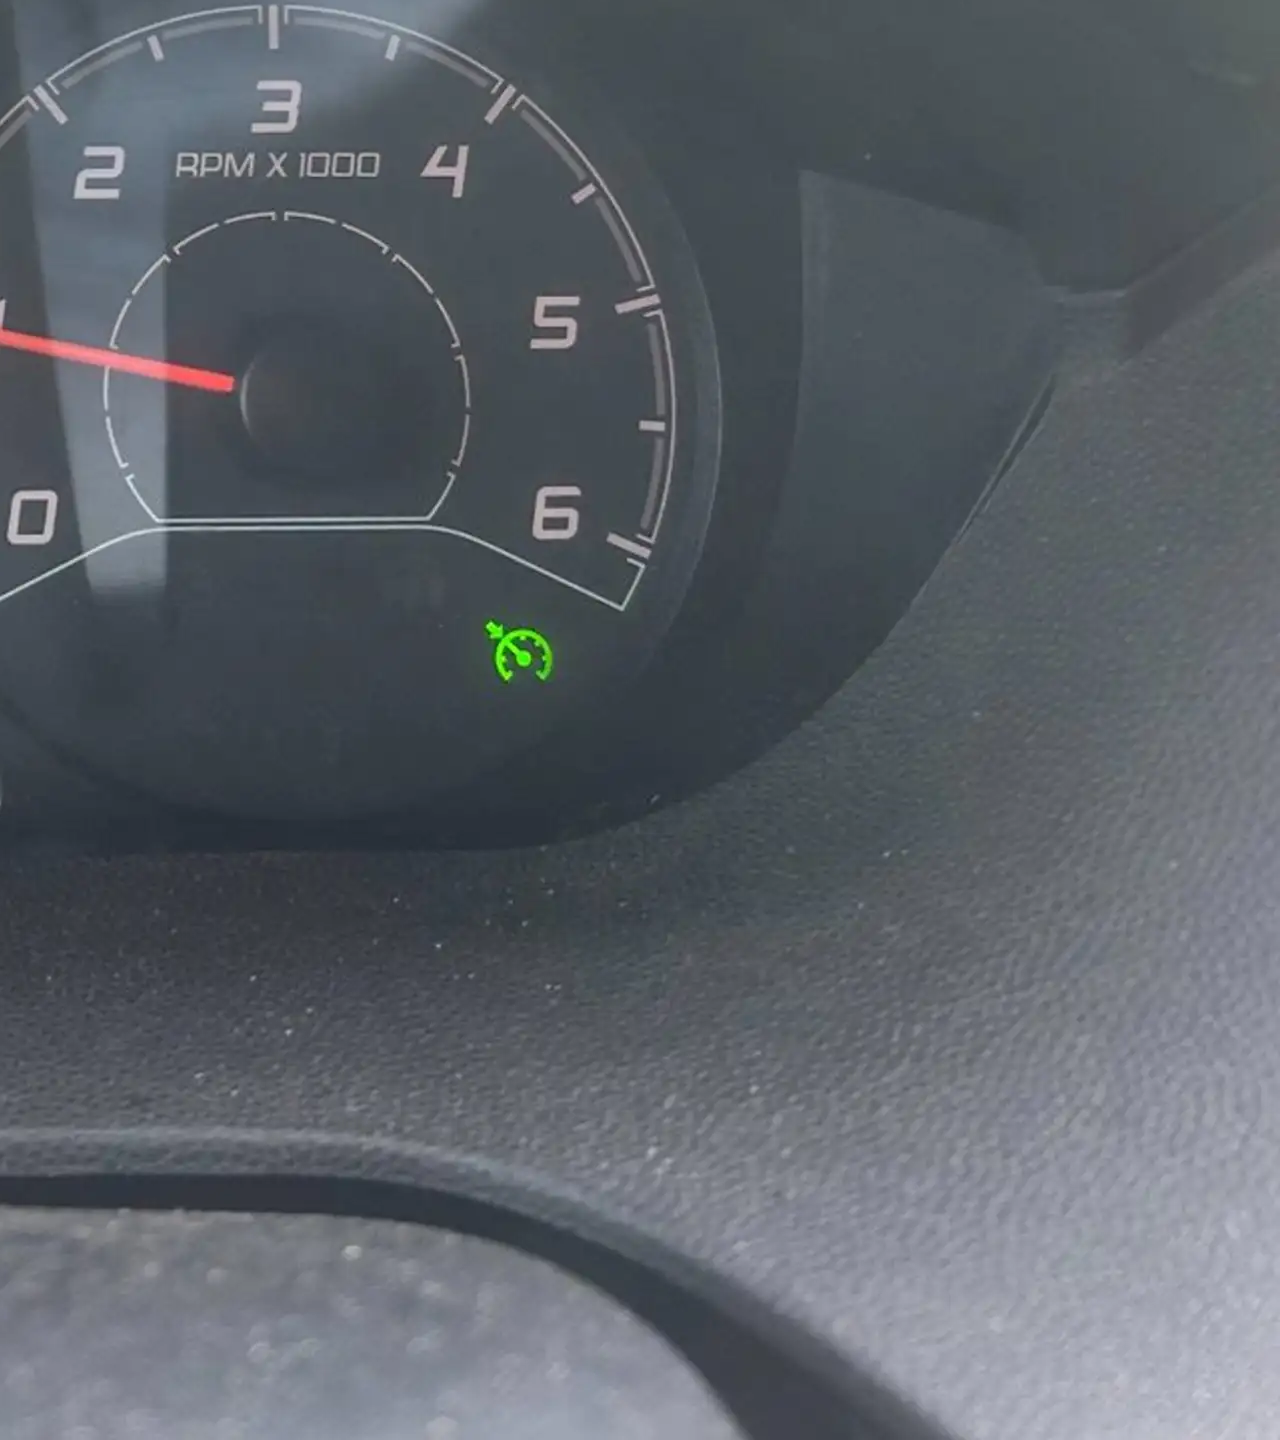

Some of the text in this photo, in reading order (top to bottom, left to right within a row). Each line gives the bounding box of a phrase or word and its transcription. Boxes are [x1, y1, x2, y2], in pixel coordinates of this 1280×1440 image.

[251, 79, 302, 133] 3
[73, 146, 126, 200] 2
[175, 151, 381, 178] RPM X 1000
[420, 145, 470, 198] 4
[530, 295, 581, 349] 5
[6, 489, 58, 545] 0
[532, 486, 582, 540] 6
